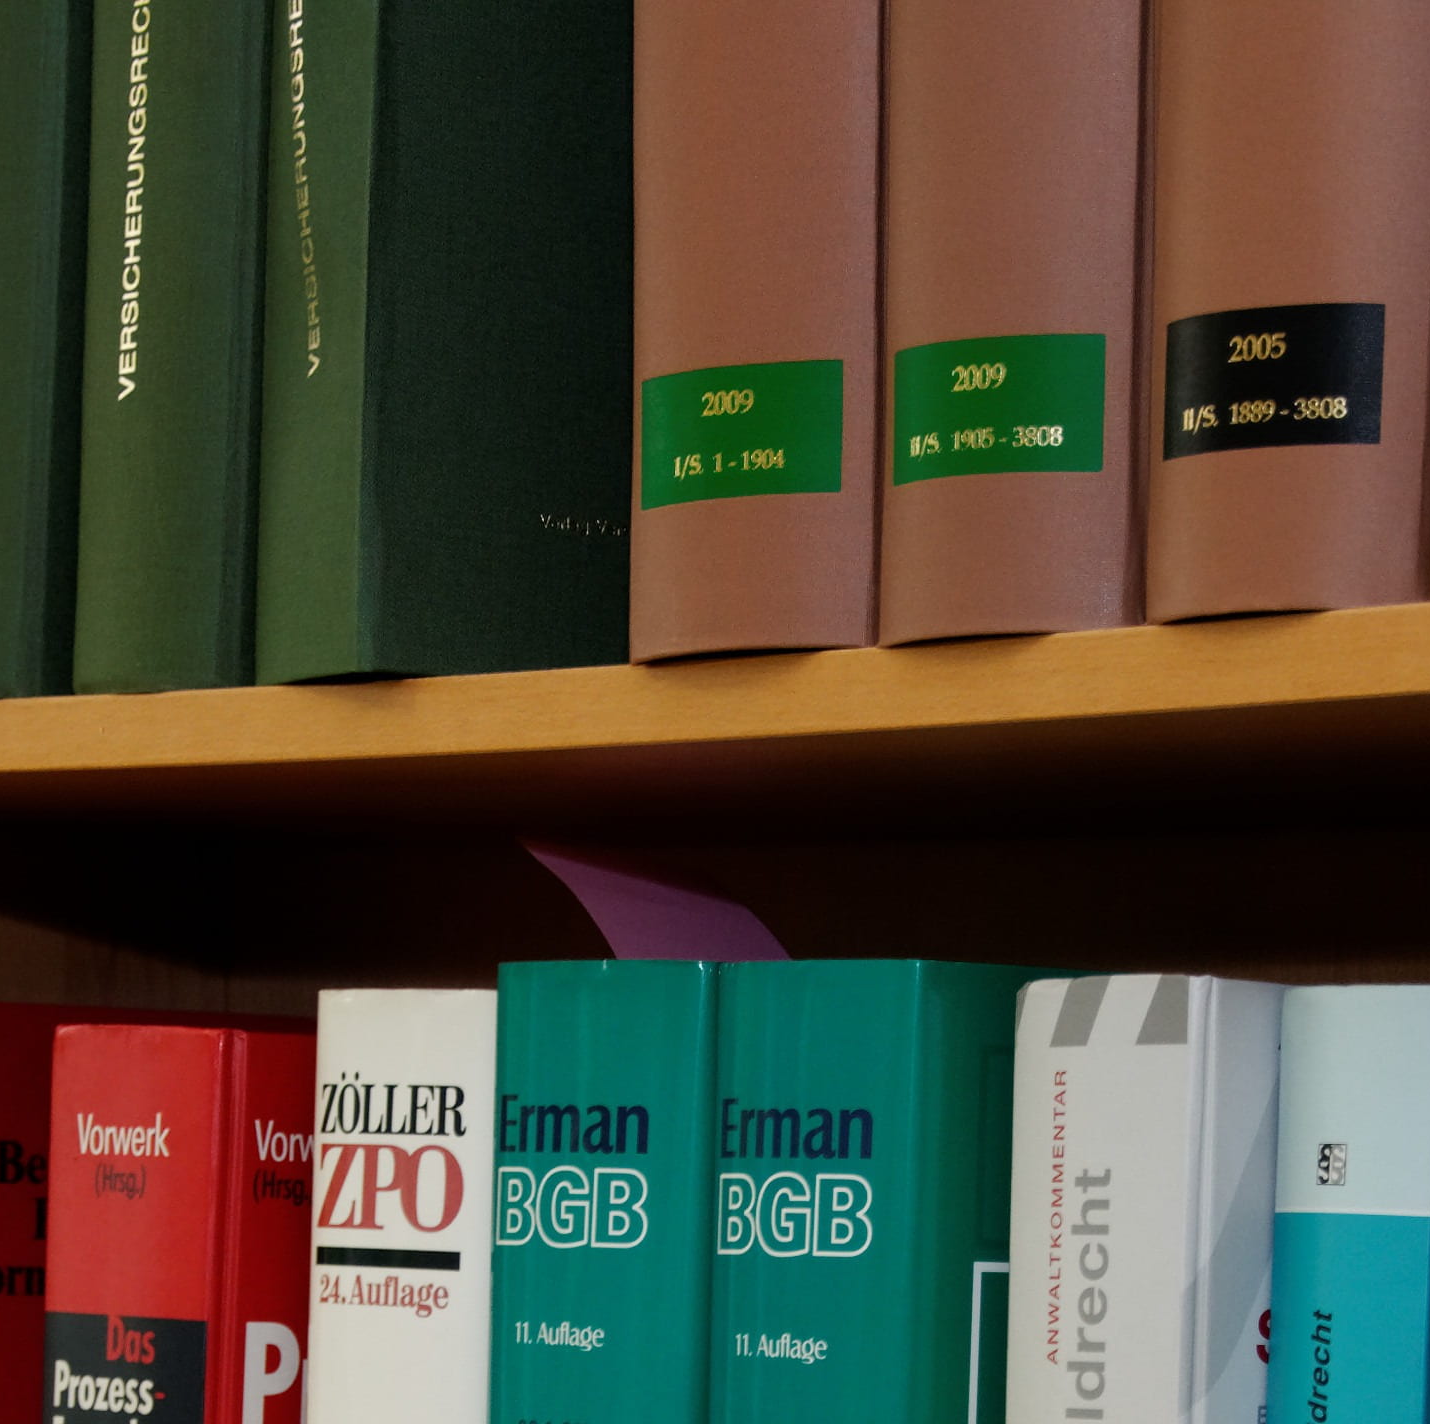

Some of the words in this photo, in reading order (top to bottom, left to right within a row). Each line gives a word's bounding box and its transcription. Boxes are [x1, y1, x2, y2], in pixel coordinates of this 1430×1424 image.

[1227, 332, 1287, 363] 2005
[951, 363, 1006, 393] 2009
[701, 389, 754, 417] 2009
[1228, 400, 1276, 425] 1889
[1293, 396, 1348, 420] 3808
[742, 448, 785, 471] 1904
[951, 425, 995, 451] 1905
[1012, 425, 1064, 447] 3808
[321, 1071, 467, 1137] ZÖLLER
[499, 1094, 650, 1154] Erman
[77, 1112, 170, 1158] Vorwerk
[720, 1097, 873, 1159] Erman
[94, 1163, 147, 1200] (Hrsg.)
[317, 1143, 464, 1233] ZPO
[496, 1165, 648, 1249] BGB
[717, 1171, 873, 1257] BGB
[1045, 1068, 1068, 1366] ANWALTKOMMENTAR
[319, 1274, 346, 1304] 24.
[349, 1275, 448, 1318] Auflage
[106, 1315, 155, 1364] Das
[515, 1321, 532, 1345] 11.
[537, 1322, 605, 1352] Auflage
[735, 1333, 753, 1357] 11.
[757, 1333, 828, 1365] Auflage
[53, 1359, 166, 1416] Prozess-
